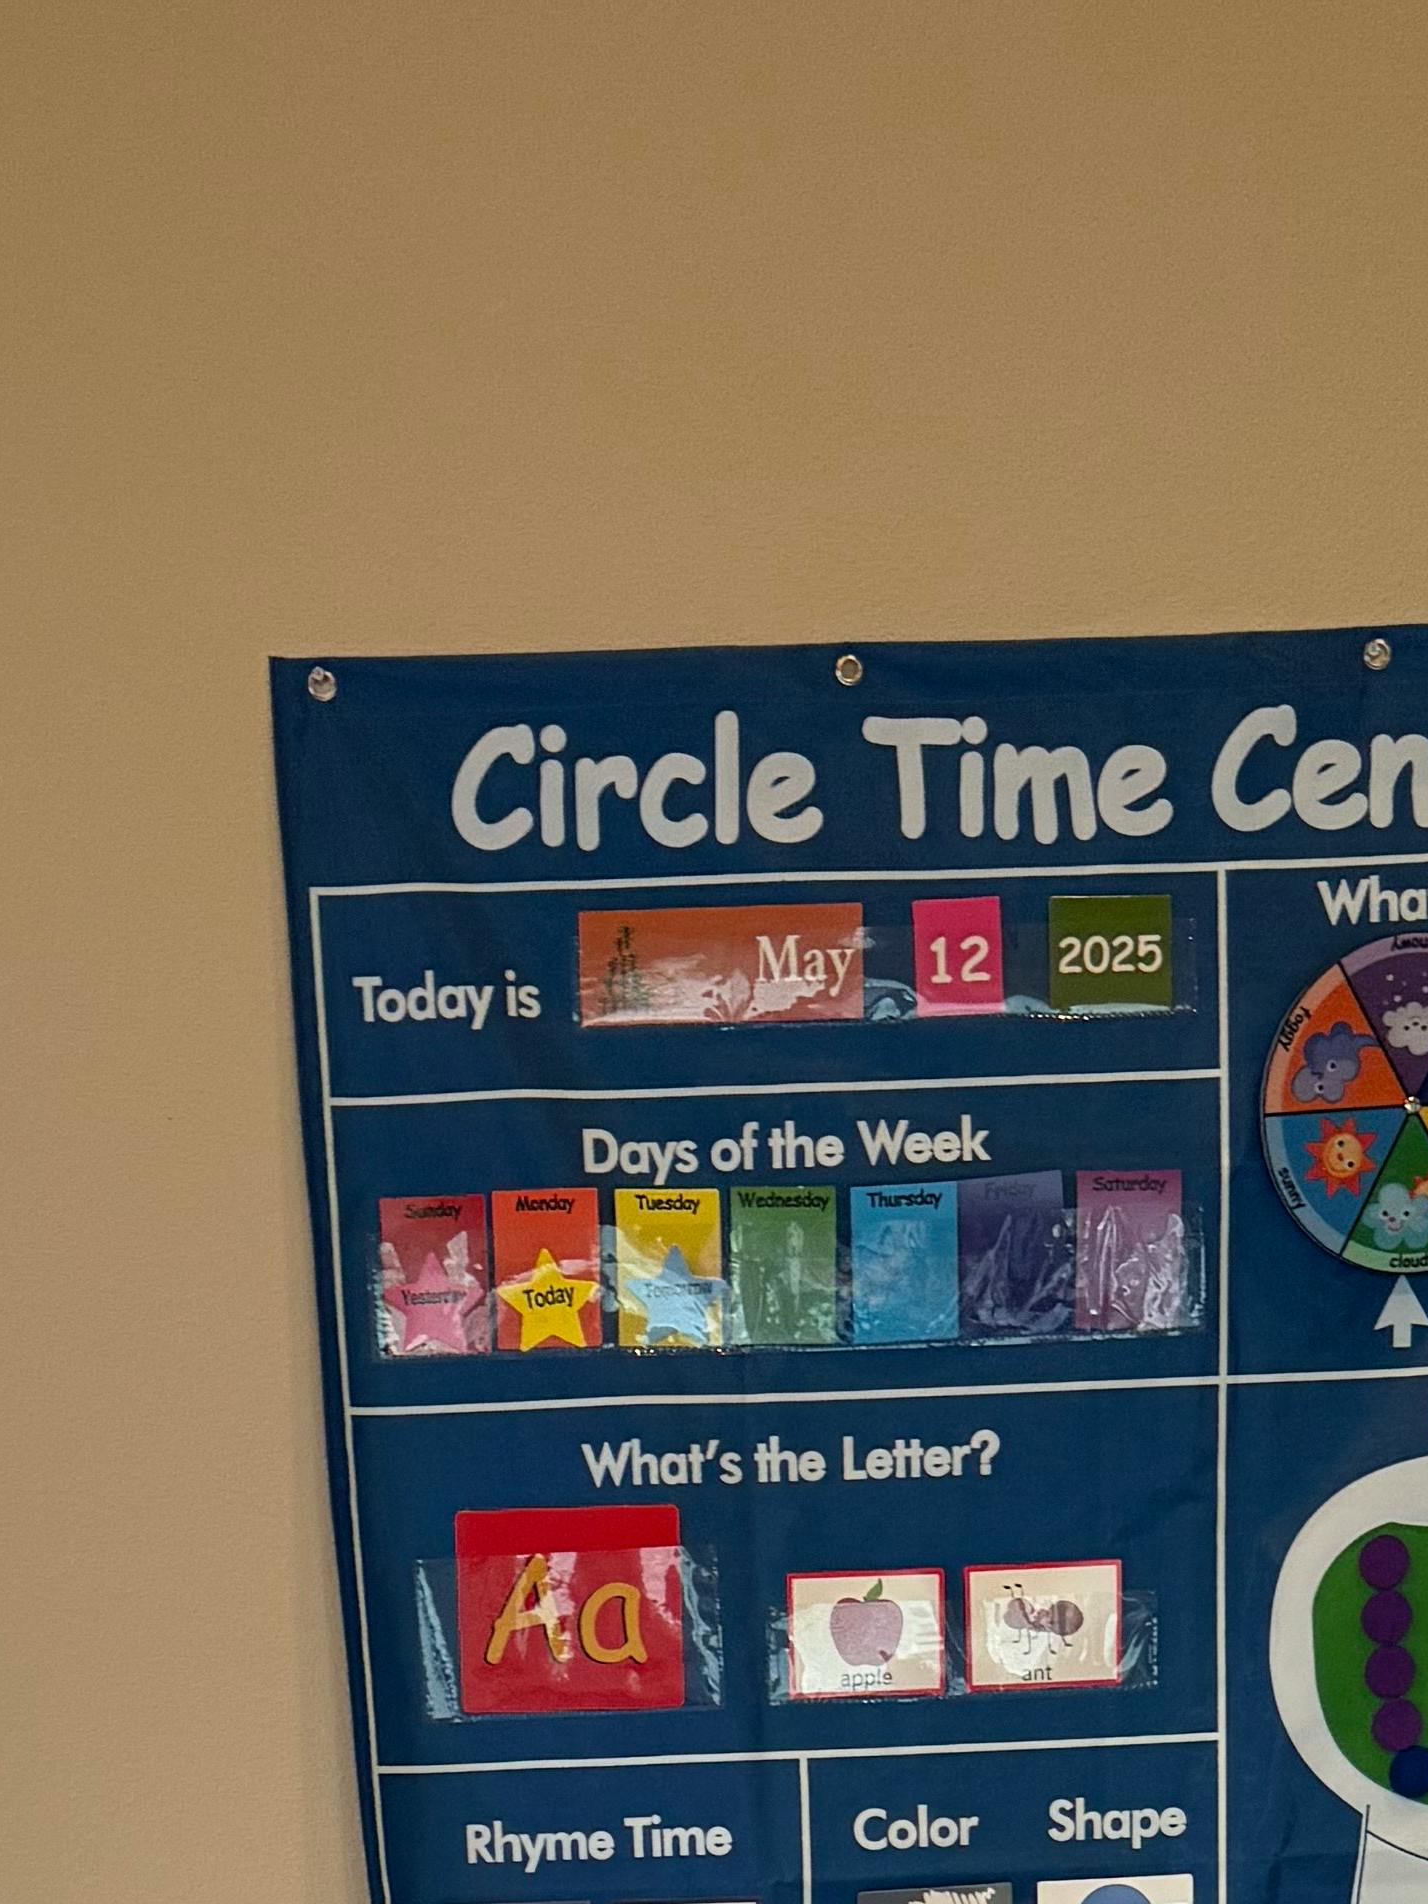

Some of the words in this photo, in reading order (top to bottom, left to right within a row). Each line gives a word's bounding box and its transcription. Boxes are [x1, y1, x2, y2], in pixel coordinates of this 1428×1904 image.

[451, 711, 824, 851] Circle
[862, 714, 1171, 843] Time
[756, 935, 858, 996] May
[929, 937, 989, 983] 12
[1058, 935, 1162, 974] 2025
[354, 970, 493, 1032] Today
[505, 970, 541, 1018] is
[1278, 1006, 1312, 1052] foggy
[583, 1127, 698, 1186] Days
[710, 1123, 760, 1171] of
[768, 1122, 844, 1167] the
[858, 1115, 991, 1166] Week
[515, 1195, 575, 1214] Monday
[635, 1195, 700, 1214] Tuesday
[738, 1192, 829, 1211] Wednesday
[867, 1191, 941, 1209] Thursday
[985, 1182, 1037, 1199] Friday
[1093, 1177, 1166, 1194] Saturday
[1277, 1167, 1306, 1211] sunny
[406, 1204, 463, 1220] Sunday
[522, 1286, 574, 1308] Today
[581, 1438, 741, 1489] What's
[754, 1438, 826, 1483] the
[842, 1429, 1000, 1481] Letter?
[484, 1554, 646, 1666] Aa
[840, 1667, 892, 1688] apple
[1021, 1665, 1052, 1682] ant
[467, 1819, 613, 1873] Rhyme
[624, 1815, 732, 1857] Time
[853, 1805, 978, 1852] Color
[1049, 1799, 1187, 1846] Shape
